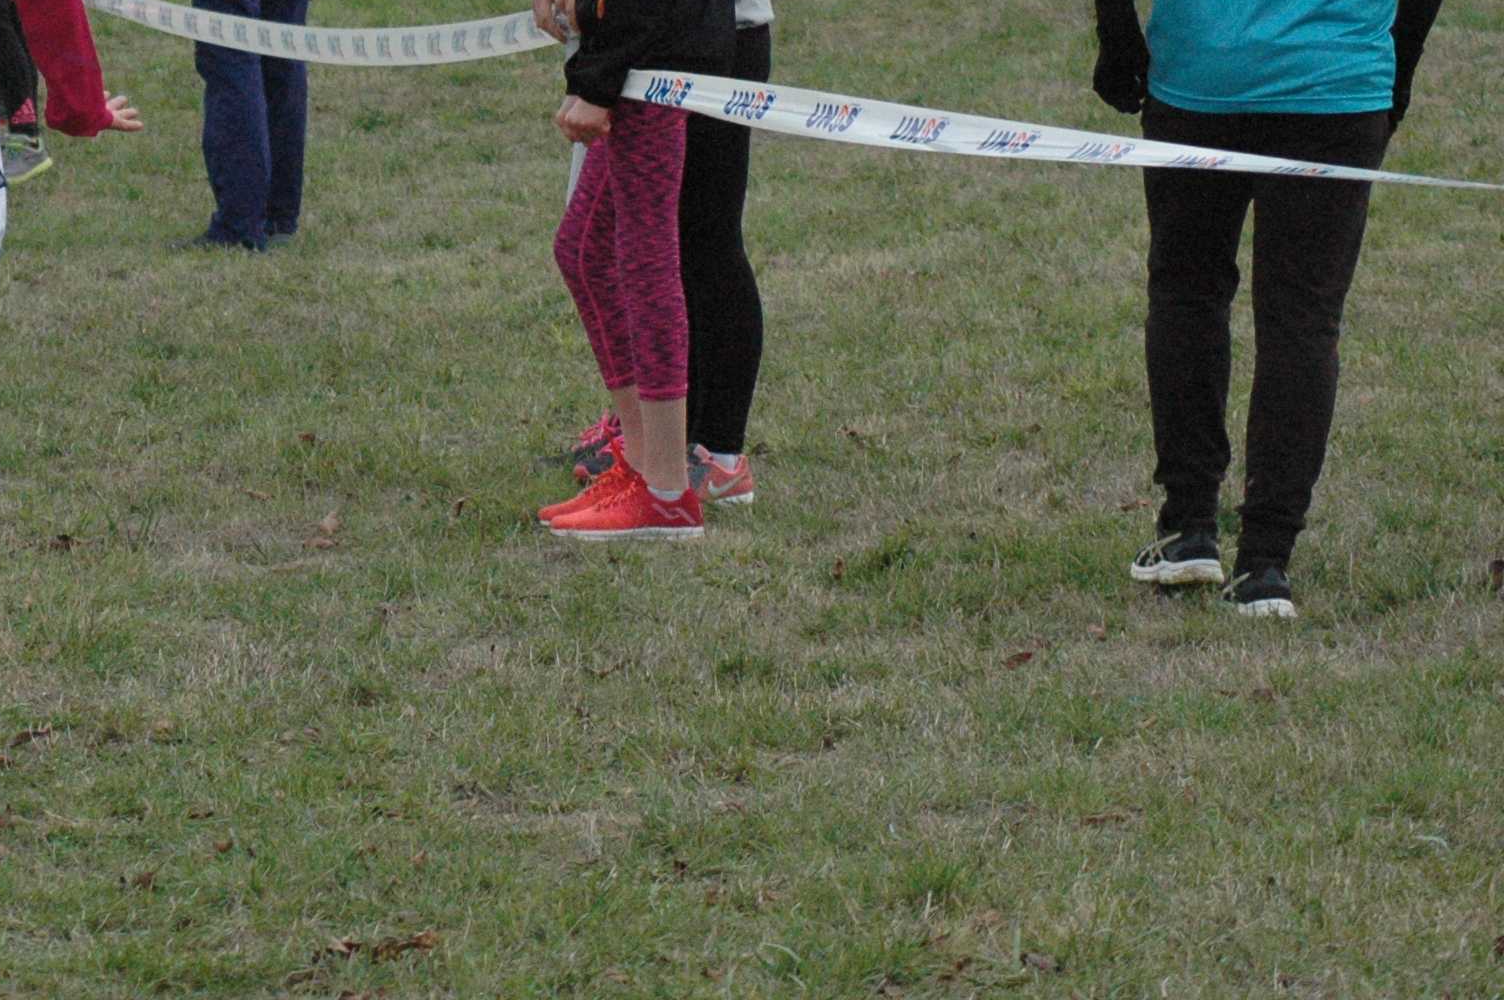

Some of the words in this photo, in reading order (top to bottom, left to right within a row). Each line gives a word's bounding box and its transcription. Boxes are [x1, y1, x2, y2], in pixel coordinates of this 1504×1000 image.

[645, 76, 693, 106] UNSS
[723, 89, 776, 120] UNSS
[805, 101, 863, 133] UNSS
[889, 115, 950, 144] UNSS
[978, 128, 1041, 153] UNSS
